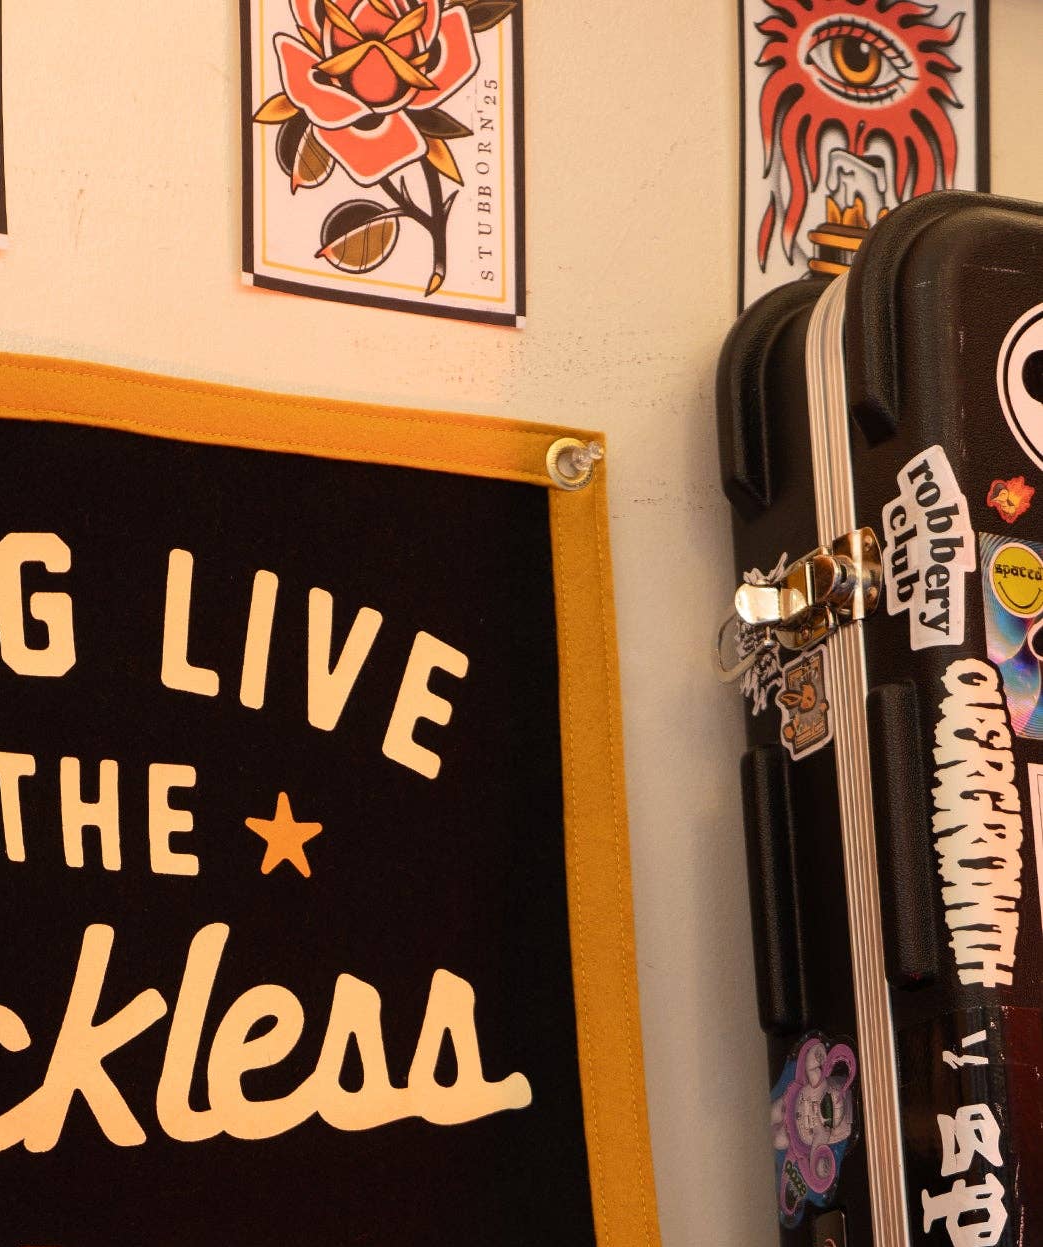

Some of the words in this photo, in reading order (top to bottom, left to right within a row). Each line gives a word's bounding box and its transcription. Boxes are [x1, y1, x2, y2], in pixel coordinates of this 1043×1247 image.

[889, 504, 921, 603] club
[907, 459, 965, 636] robbery
[160, 548, 469, 780] LIVE
